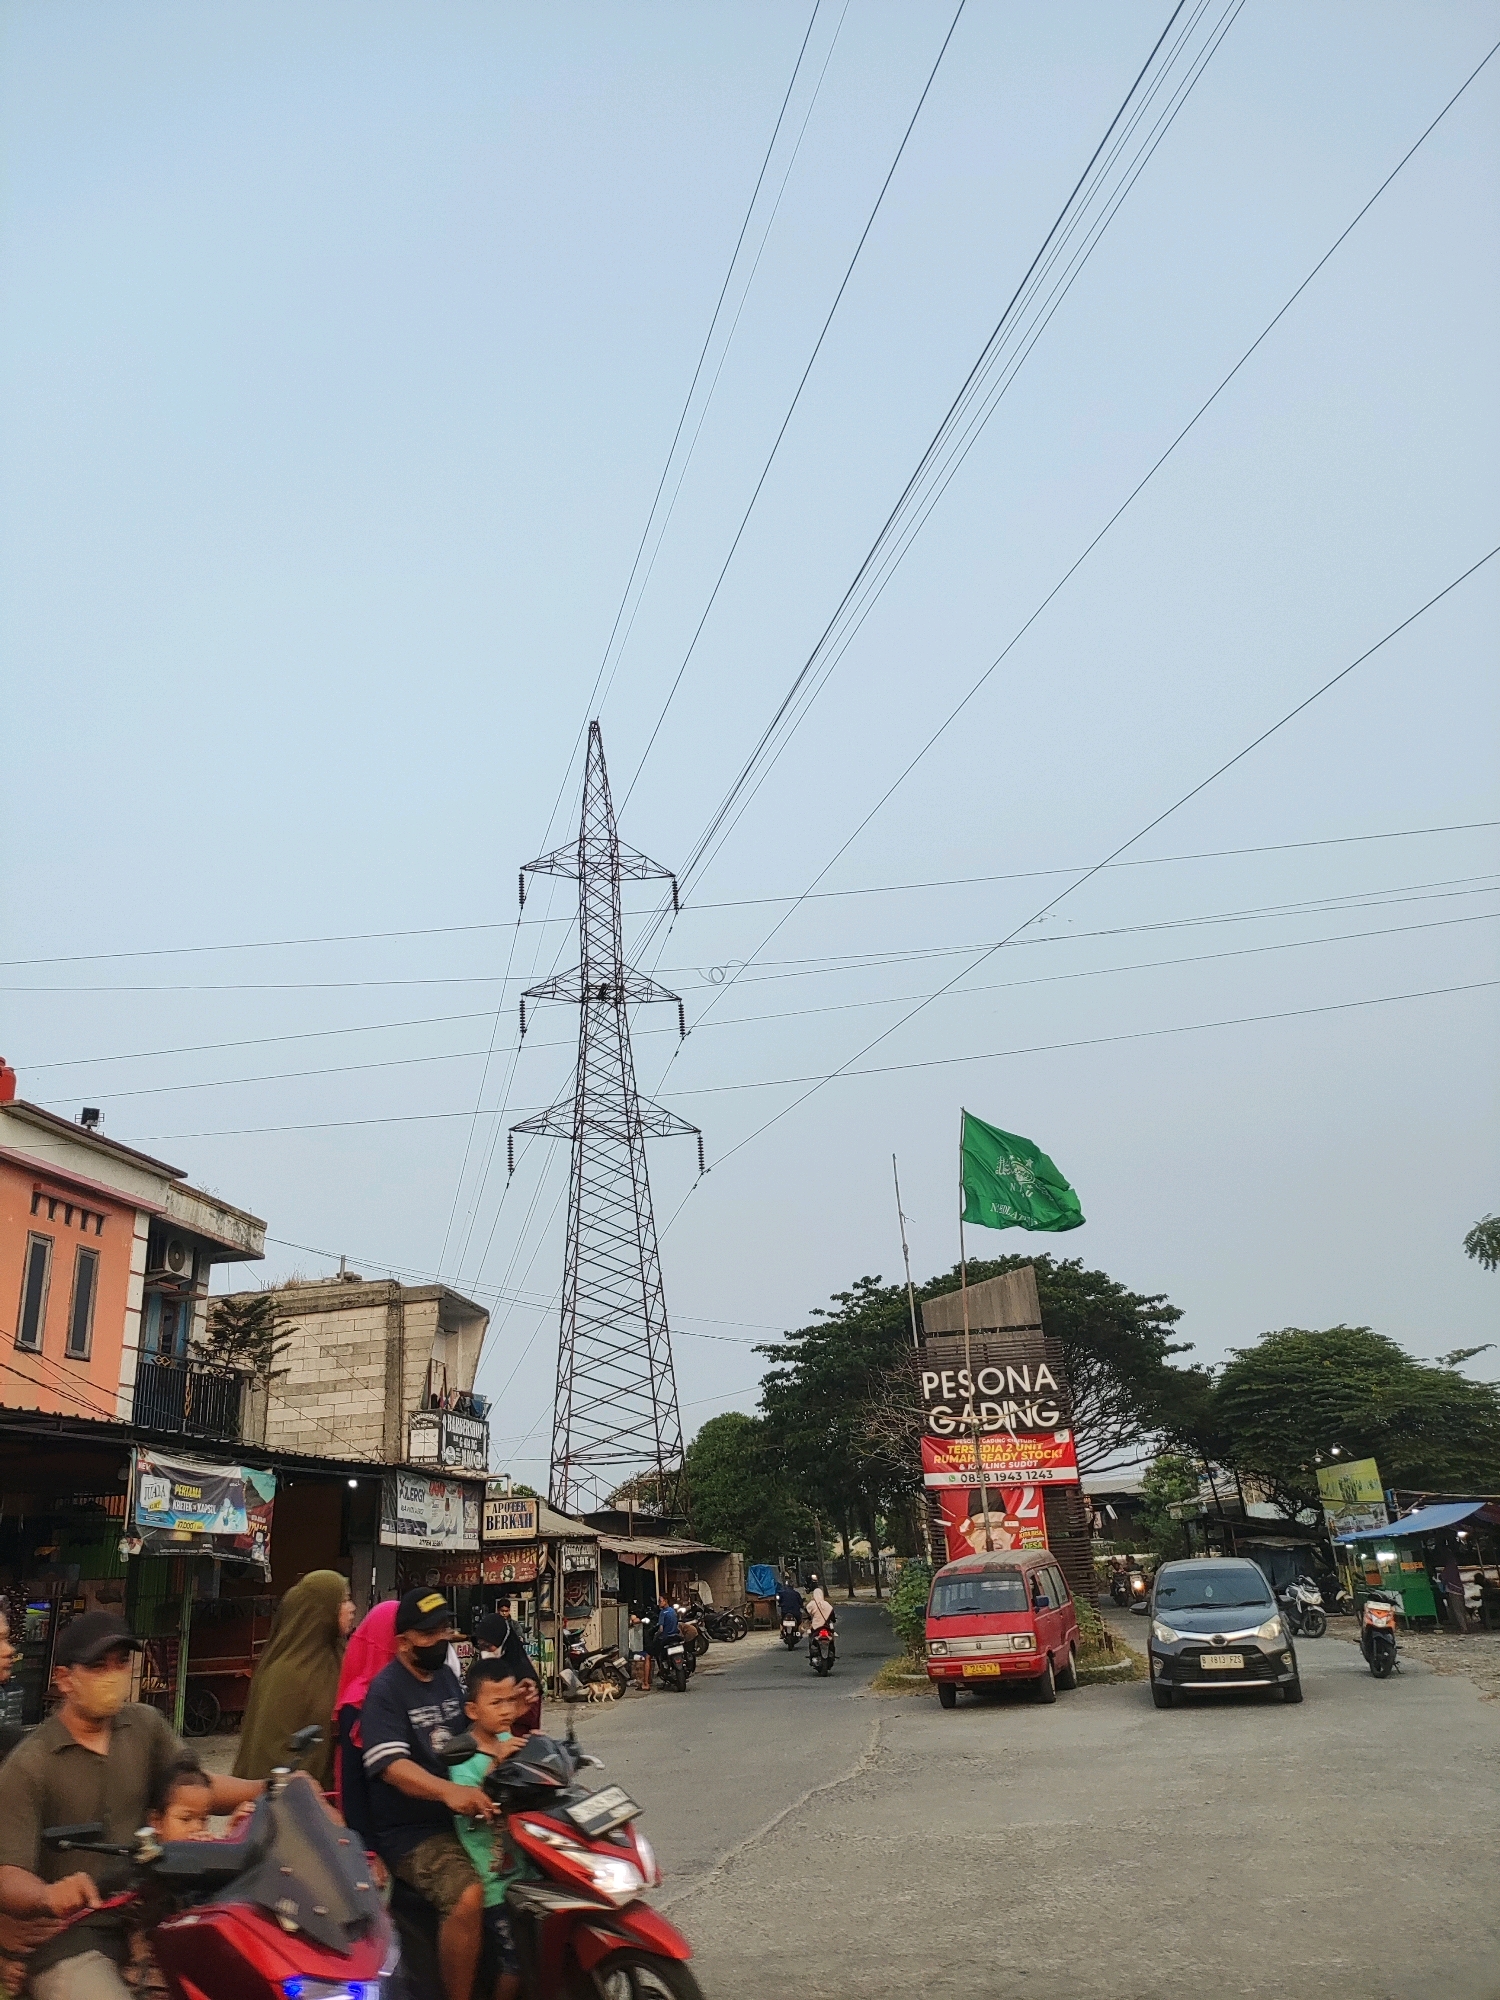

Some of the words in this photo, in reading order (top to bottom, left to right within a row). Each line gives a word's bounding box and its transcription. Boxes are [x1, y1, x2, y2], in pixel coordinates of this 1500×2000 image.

[922, 1363, 1059, 1399] PESONA
[929, 1398, 1060, 1434] GADING
[947, 1445, 1003, 1454] TERSEDIA
[1006, 1444, 1012, 1452] 2
[1016, 1443, 1044, 1451] UNIT
[933, 1453, 974, 1464] RUMAH
[981, 1452, 1017, 1462] READY
[1022, 1449, 1063, 1459] STOCK!
[1009, 1460, 1038, 1468] SUDUT
[995, 1472, 1022, 1482] 1943
[1026, 1470, 1054, 1480] 1243
[175, 1484, 202, 1499] PERTAMA
[492, 1501, 527, 1514] APOTEK
[1015, 1486, 1039, 1518] 2
[486, 1513, 533, 1530] BERKAH
